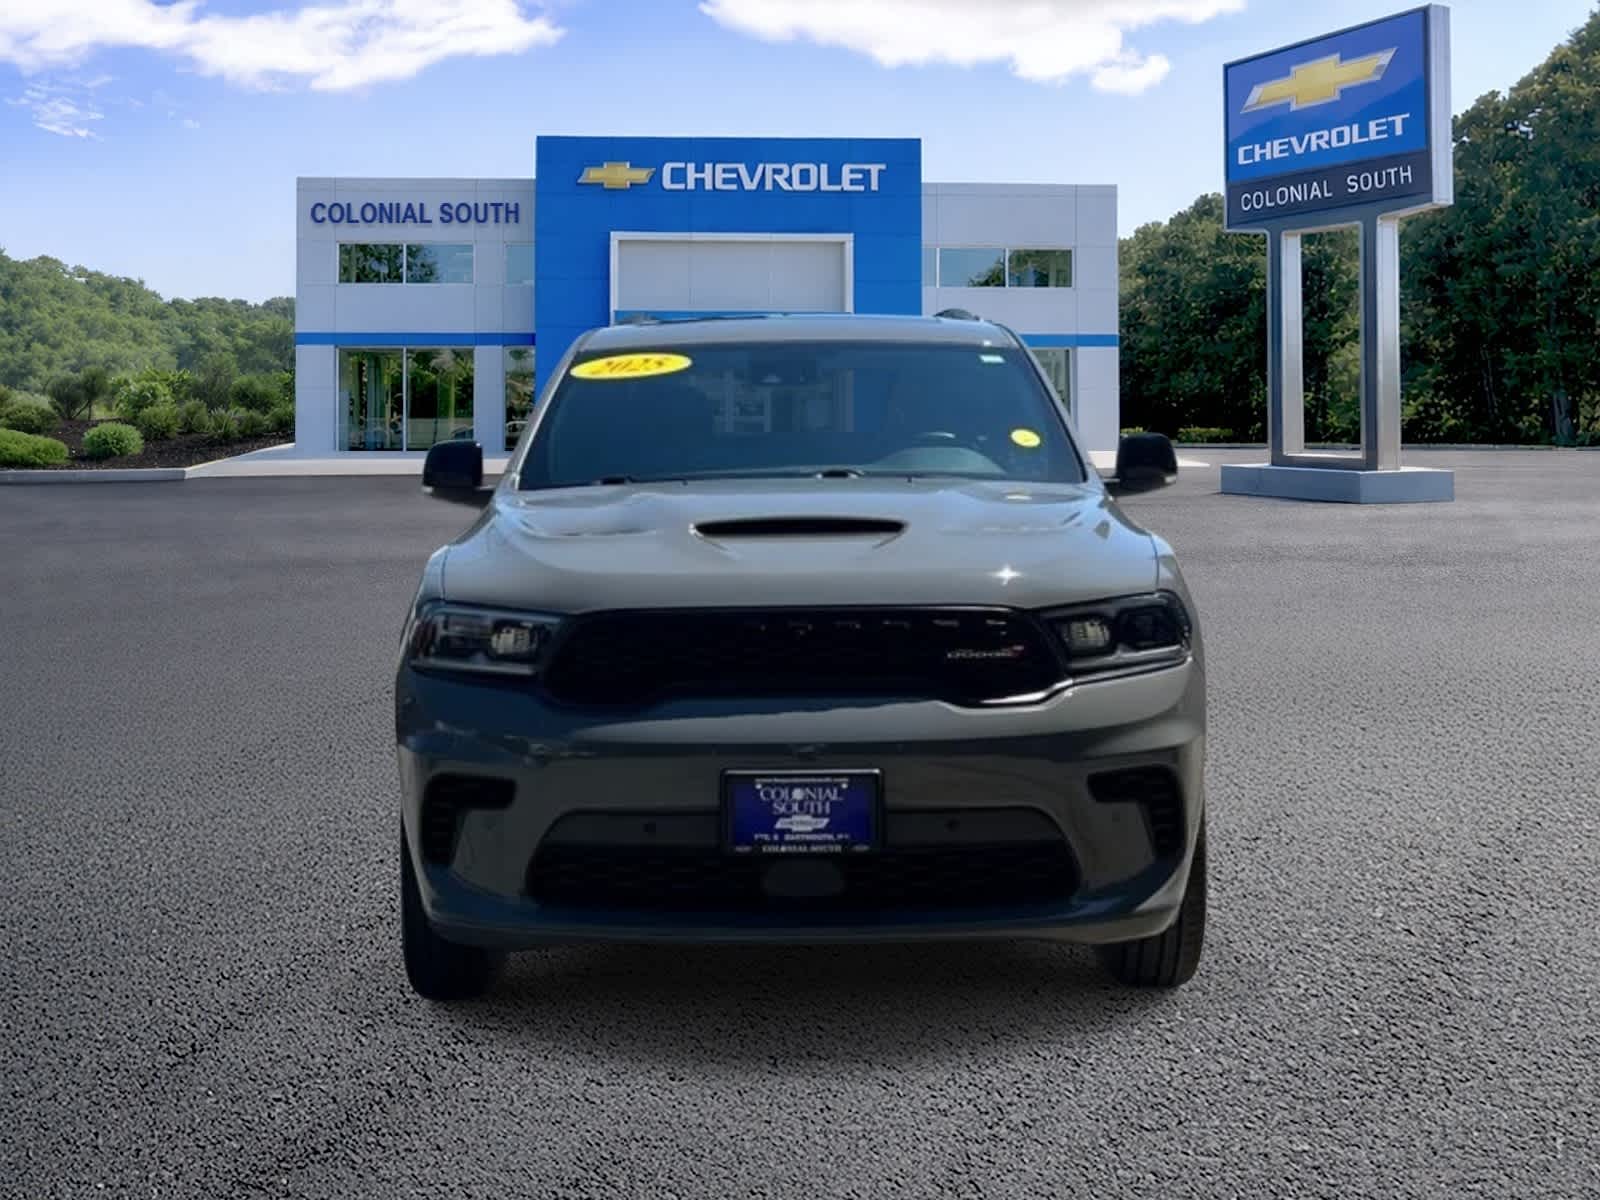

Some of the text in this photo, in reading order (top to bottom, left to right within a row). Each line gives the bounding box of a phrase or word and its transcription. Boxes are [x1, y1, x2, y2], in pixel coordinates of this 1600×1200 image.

[1237, 113, 1411, 165] CHEVROLET
[662, 162, 887, 192] CHEVROLET
[1240, 165, 1413, 212] COLONIAL SOUTH
[310, 202, 520, 224] COLONIAL SOUTH
[759, 786, 845, 801] COLONIAL
[772, 801, 832, 815] SOUTH
